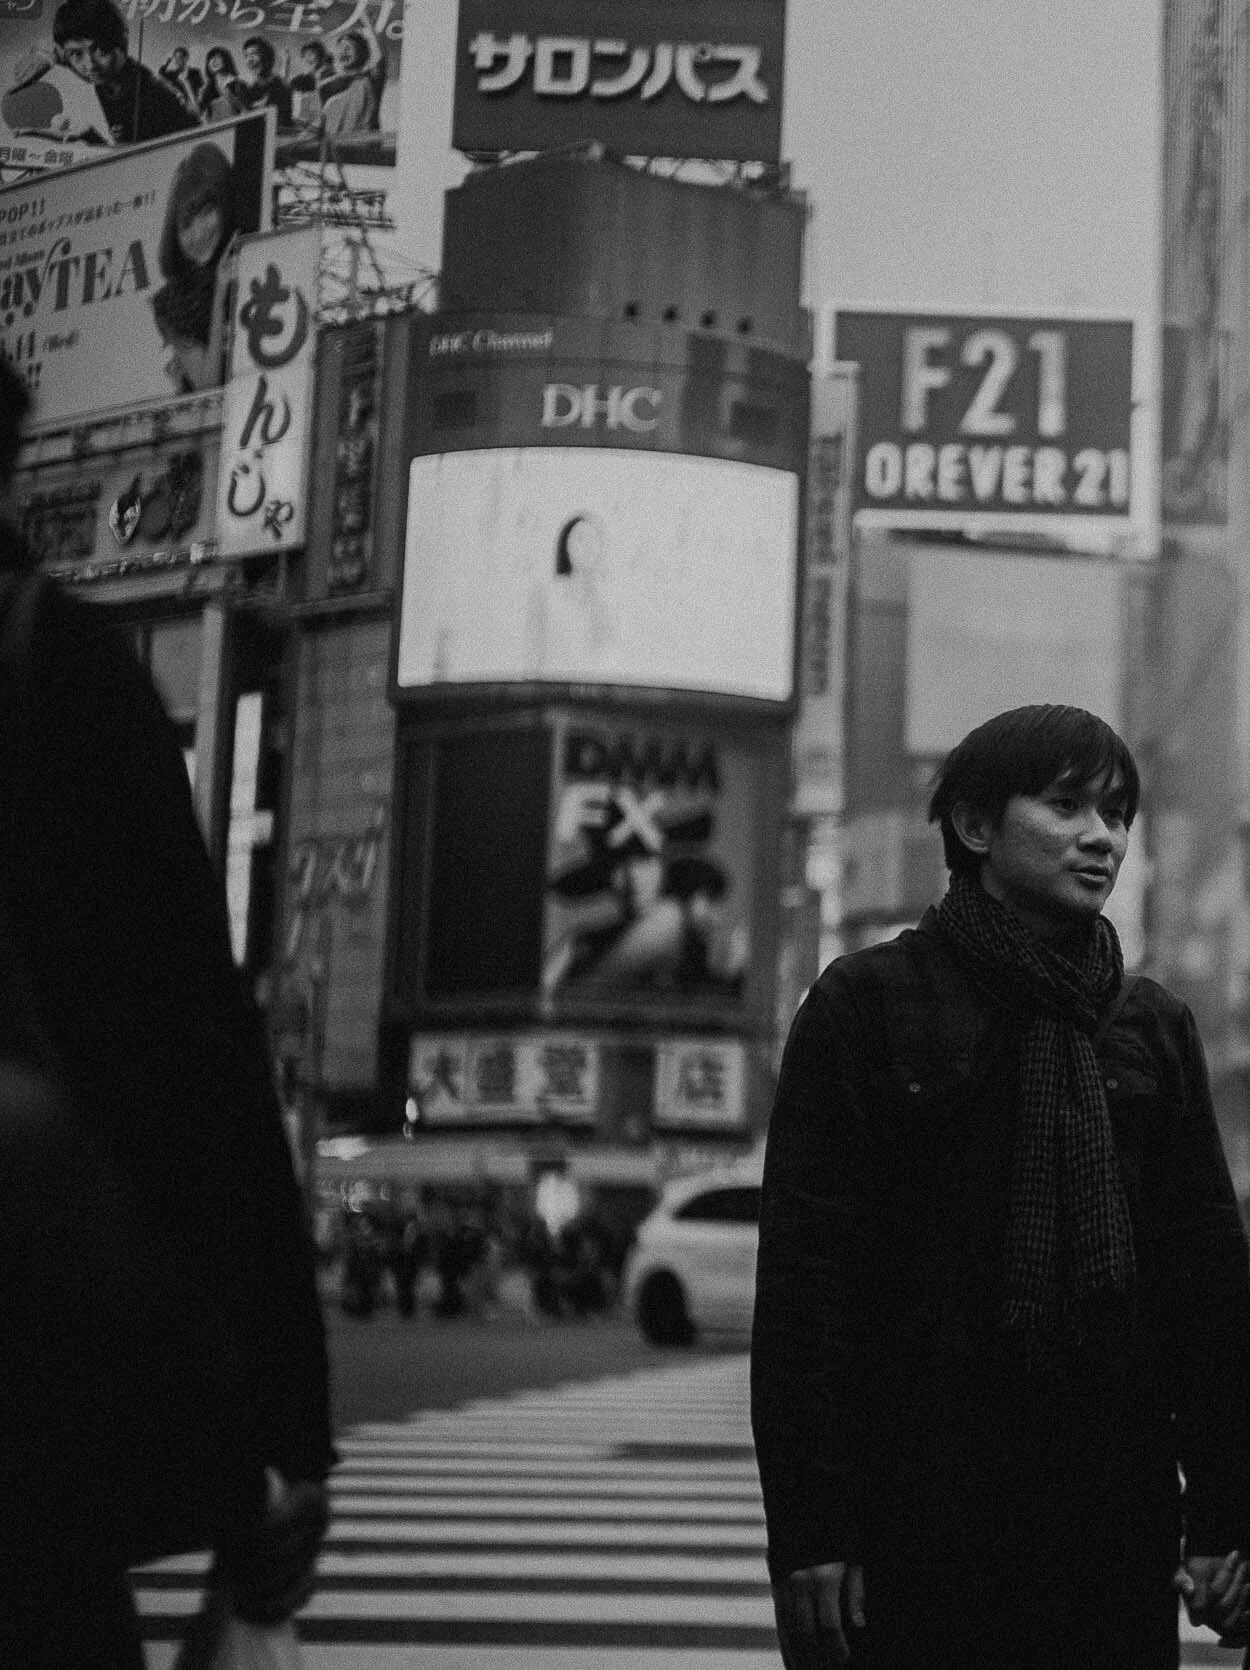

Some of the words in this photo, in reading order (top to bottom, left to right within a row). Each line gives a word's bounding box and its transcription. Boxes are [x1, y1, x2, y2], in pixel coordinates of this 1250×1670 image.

[469, 33, 769, 103] サロンパス
[541, 382, 663, 432] DHC
[902, 325, 1065, 438] F21
[554, 781, 663, 851] FX
